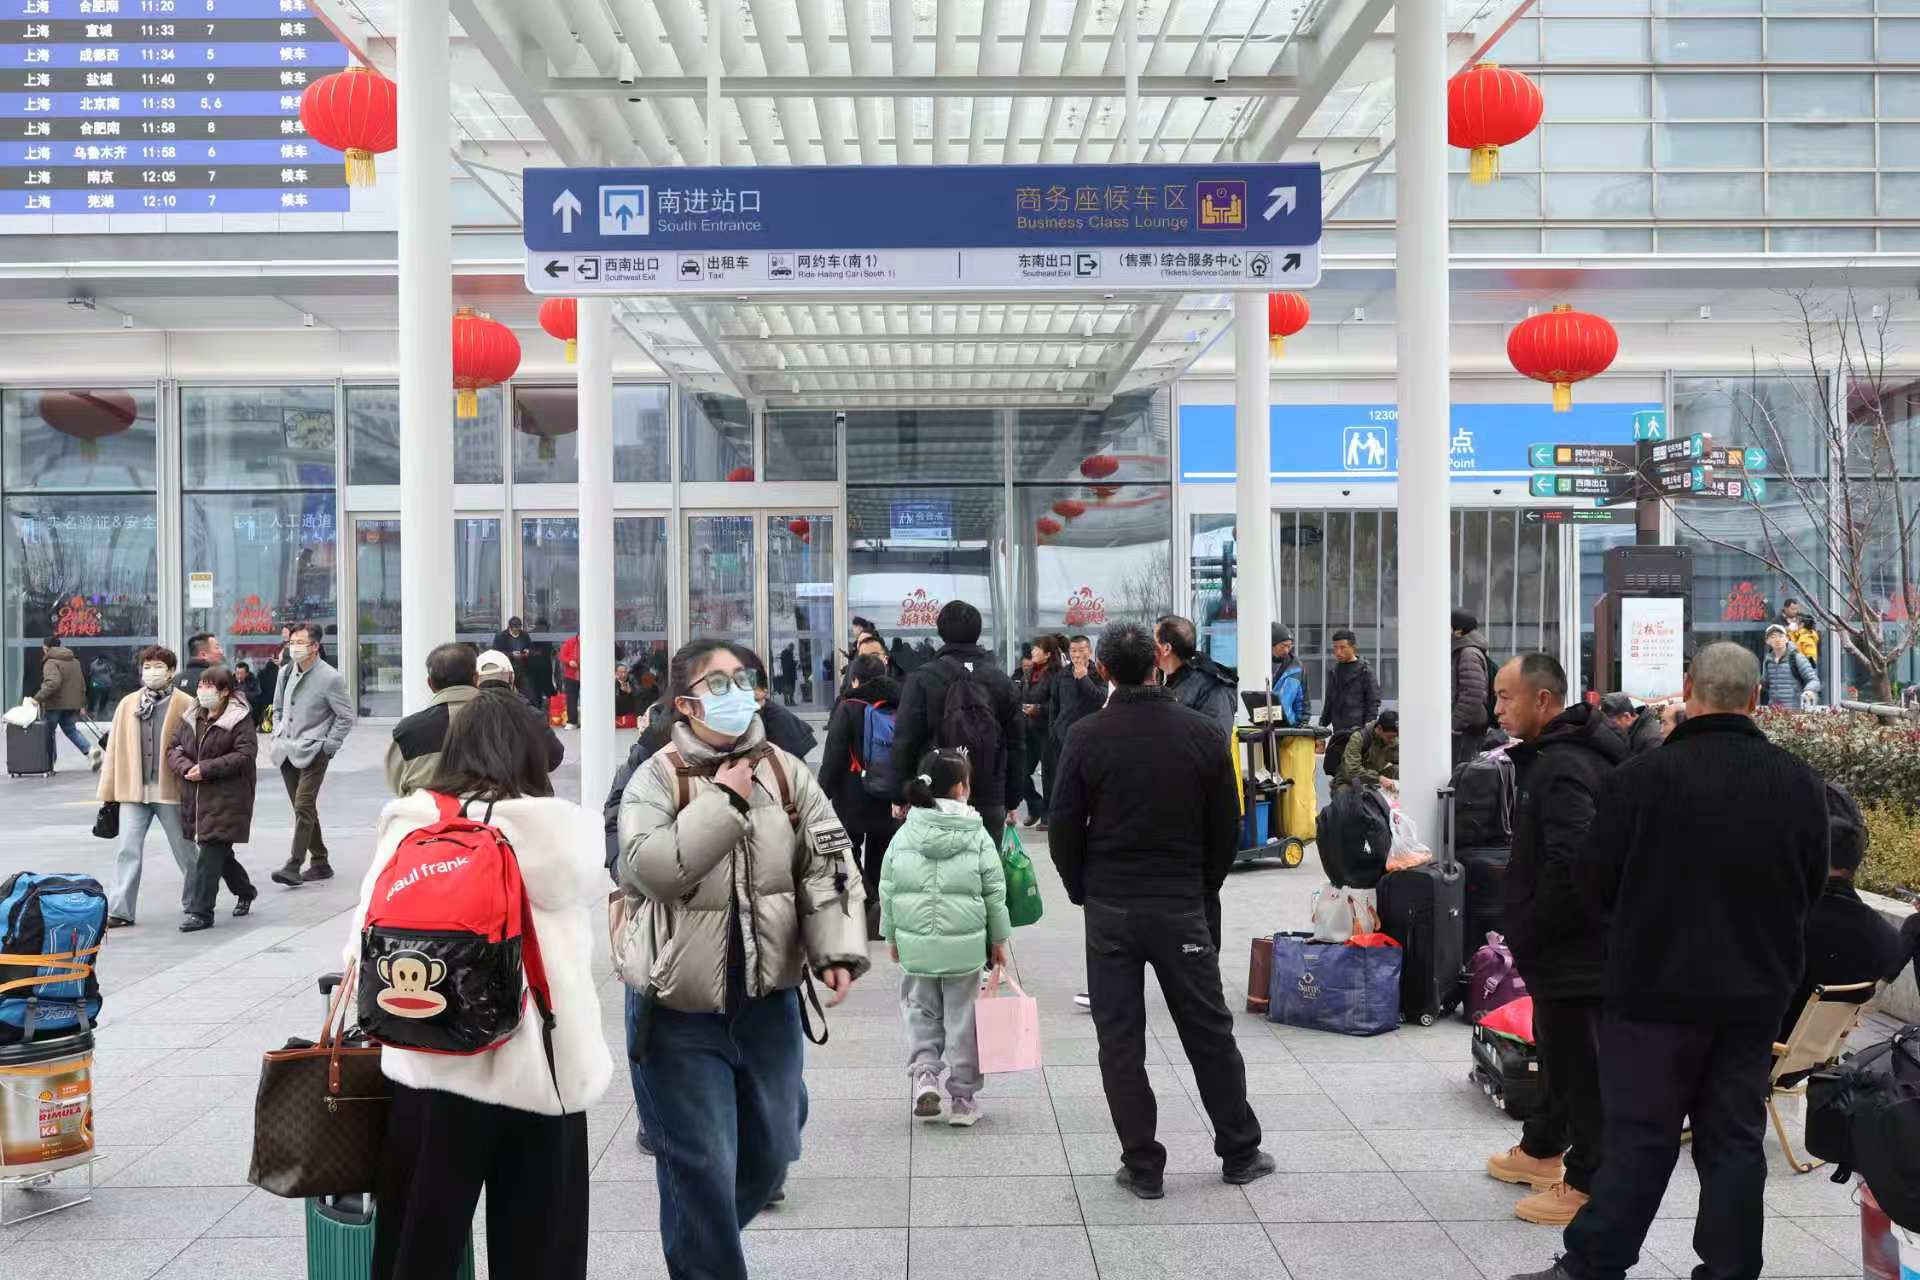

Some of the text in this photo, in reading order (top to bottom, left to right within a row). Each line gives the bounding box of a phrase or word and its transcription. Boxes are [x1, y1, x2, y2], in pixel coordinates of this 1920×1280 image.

[24, 0, 305, 13] 上海 合肥南 11:20 8 候车
[24, 25, 49, 37] 上海
[142, 25, 174, 35] 11:33
[208, 25, 213, 34] 7
[280, 23, 305, 35] 候车
[24, 48, 306, 62] 上海 成都西 11:34 5 候车
[24, 74, 49, 86] 上海
[143, 74, 174, 84] 11:40
[207, 74, 214, 84] 9
[280, 72, 306, 85] 候车
[24, 98, 50, 111] 上海
[80, 97, 119, 110] 北京南
[143, 98, 175, 108] 11:53
[201, 98, 221, 109] 5,6
[24, 122, 49, 135] 上海
[80, 122, 119, 134] 合肥南
[143, 123, 175, 132] 11:58
[208, 122, 214, 132] 8
[24, 145, 307, 160] 上海 乌鲁木齐 11:58 6 候车
[25, 169, 307, 184] 上海 南京 12:05 7 候车
[25, 196, 50, 208] 上海
[144, 196, 176, 206] 12:10
[209, 195, 215, 205] 7
[282, 194, 307, 206] 候车
[657, 188, 760, 214] 南进站口
[1016, 185, 1188, 212] 商务座候车区
[658, 219, 761, 232] South Entrance
[1017, 215, 1189, 231] Business Class Lounge
[605, 256, 659, 271] 西南出口
[707, 255, 749, 270] 出租车
[1018, 253, 1072, 268] 东南出口
[605, 273, 656, 281] Southwest Exit
[708, 272, 724, 280] Taxi
[799, 270, 815, 278] Ride
[1022, 269, 1071, 277] Southeast Exit
[1192, 269, 1218, 277] Service
[420, 856, 469, 878] frank
[40, 1106, 81, 1121] RIMULA
[41, 1126, 57, 1137] K4
